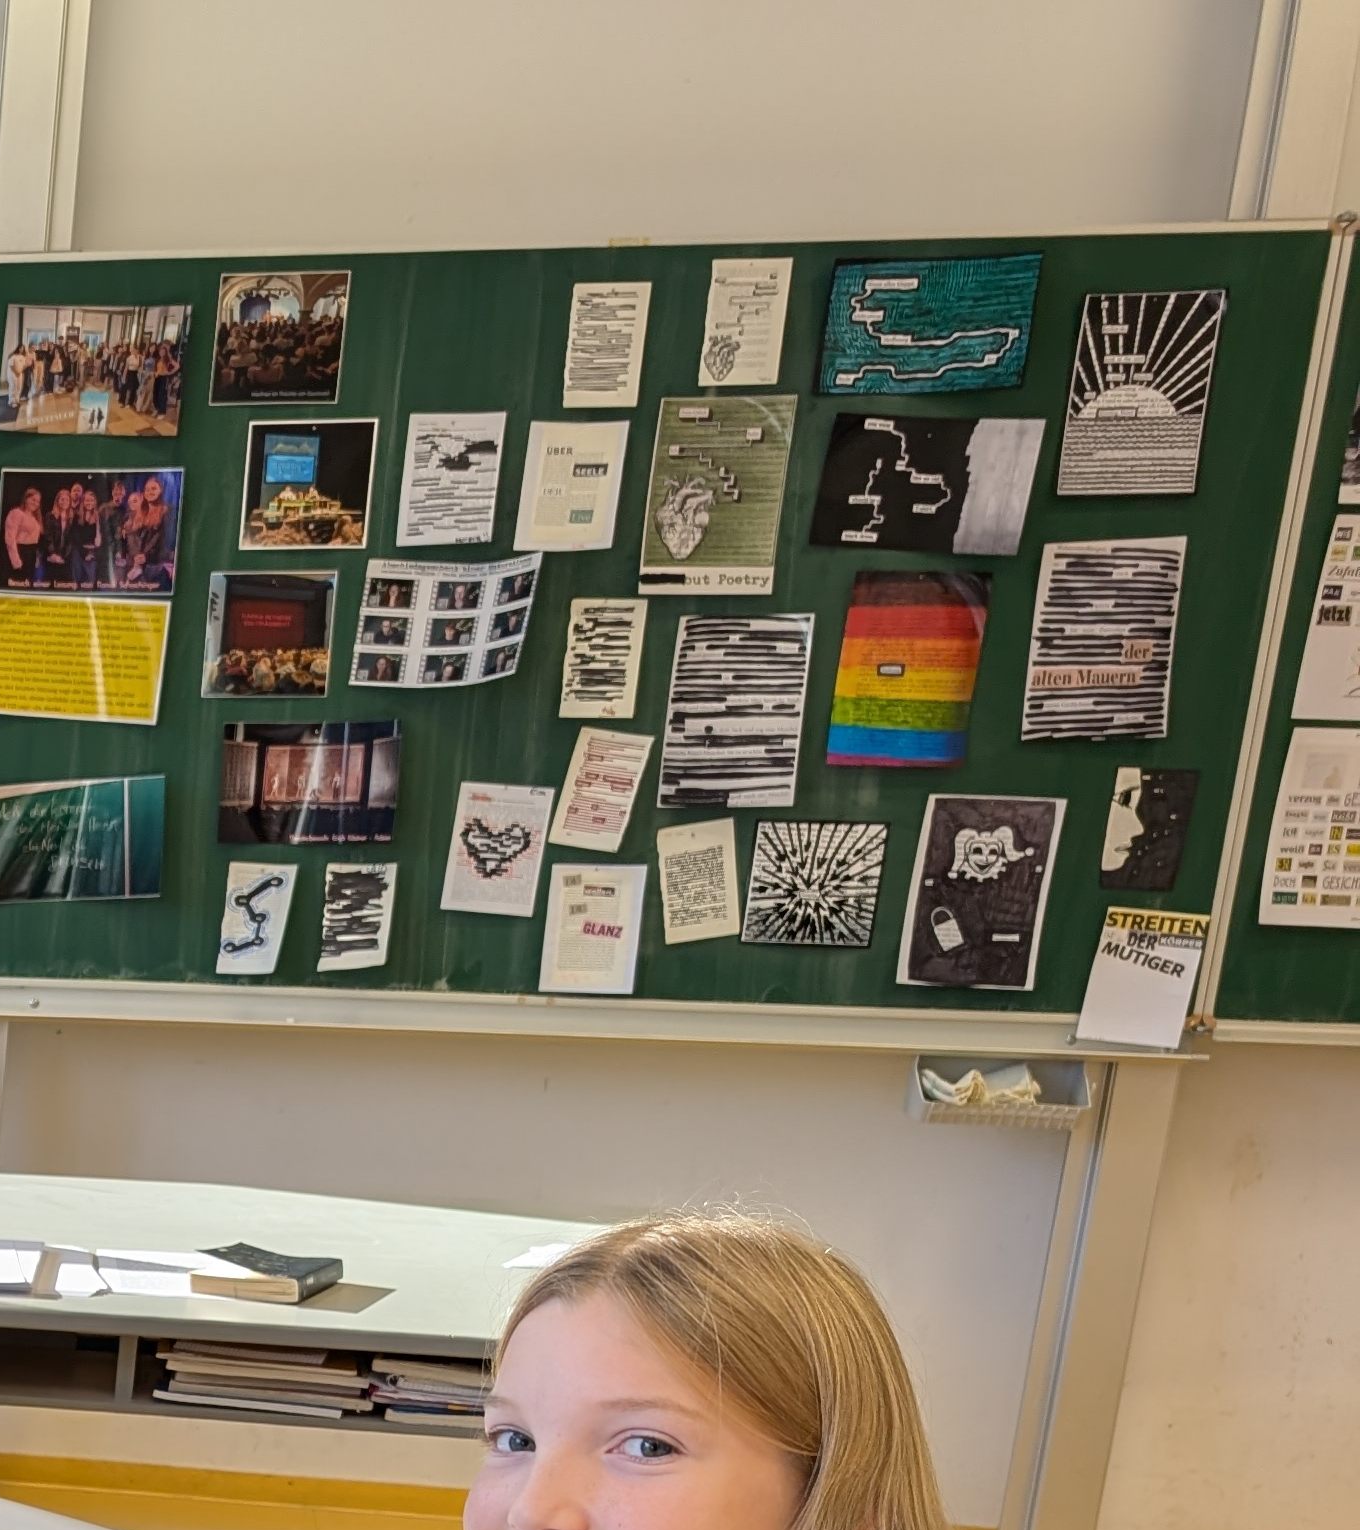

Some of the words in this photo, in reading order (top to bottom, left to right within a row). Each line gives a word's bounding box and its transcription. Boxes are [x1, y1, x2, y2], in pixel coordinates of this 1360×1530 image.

[718, 574, 770, 588] Poetry
[1317, 605, 1352, 625] jetzt
[1124, 643, 1150, 660] der
[1032, 670, 1072, 687] alten
[1077, 669, 1137, 686] Mauern
[582, 922, 624, 939] GLANZ
[1106, 912, 1210, 937] STREITEN
[1127, 931, 1158, 951] DER
[1101, 941, 1186, 979] MUTIGER
